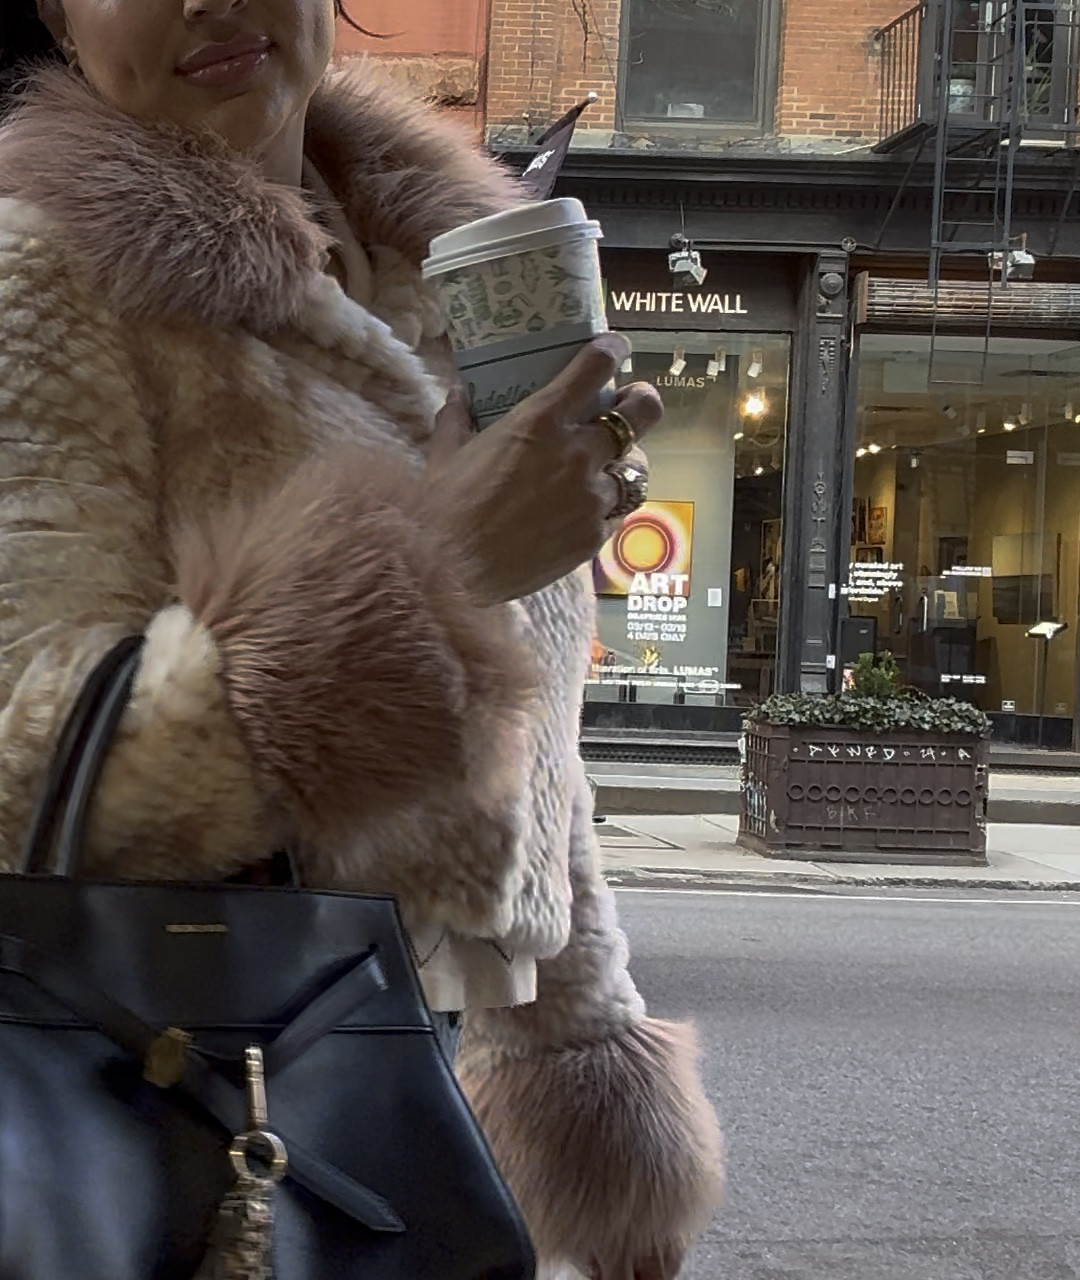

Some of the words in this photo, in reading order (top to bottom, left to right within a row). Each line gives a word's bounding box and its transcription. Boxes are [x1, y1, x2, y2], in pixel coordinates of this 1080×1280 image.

[611, 291, 684, 312] WHITE
[687, 293, 748, 314] WALL
[656, 376, 705, 388] LUMAS
[629, 573, 689, 595] ART
[627, 595, 687, 613] DROP
